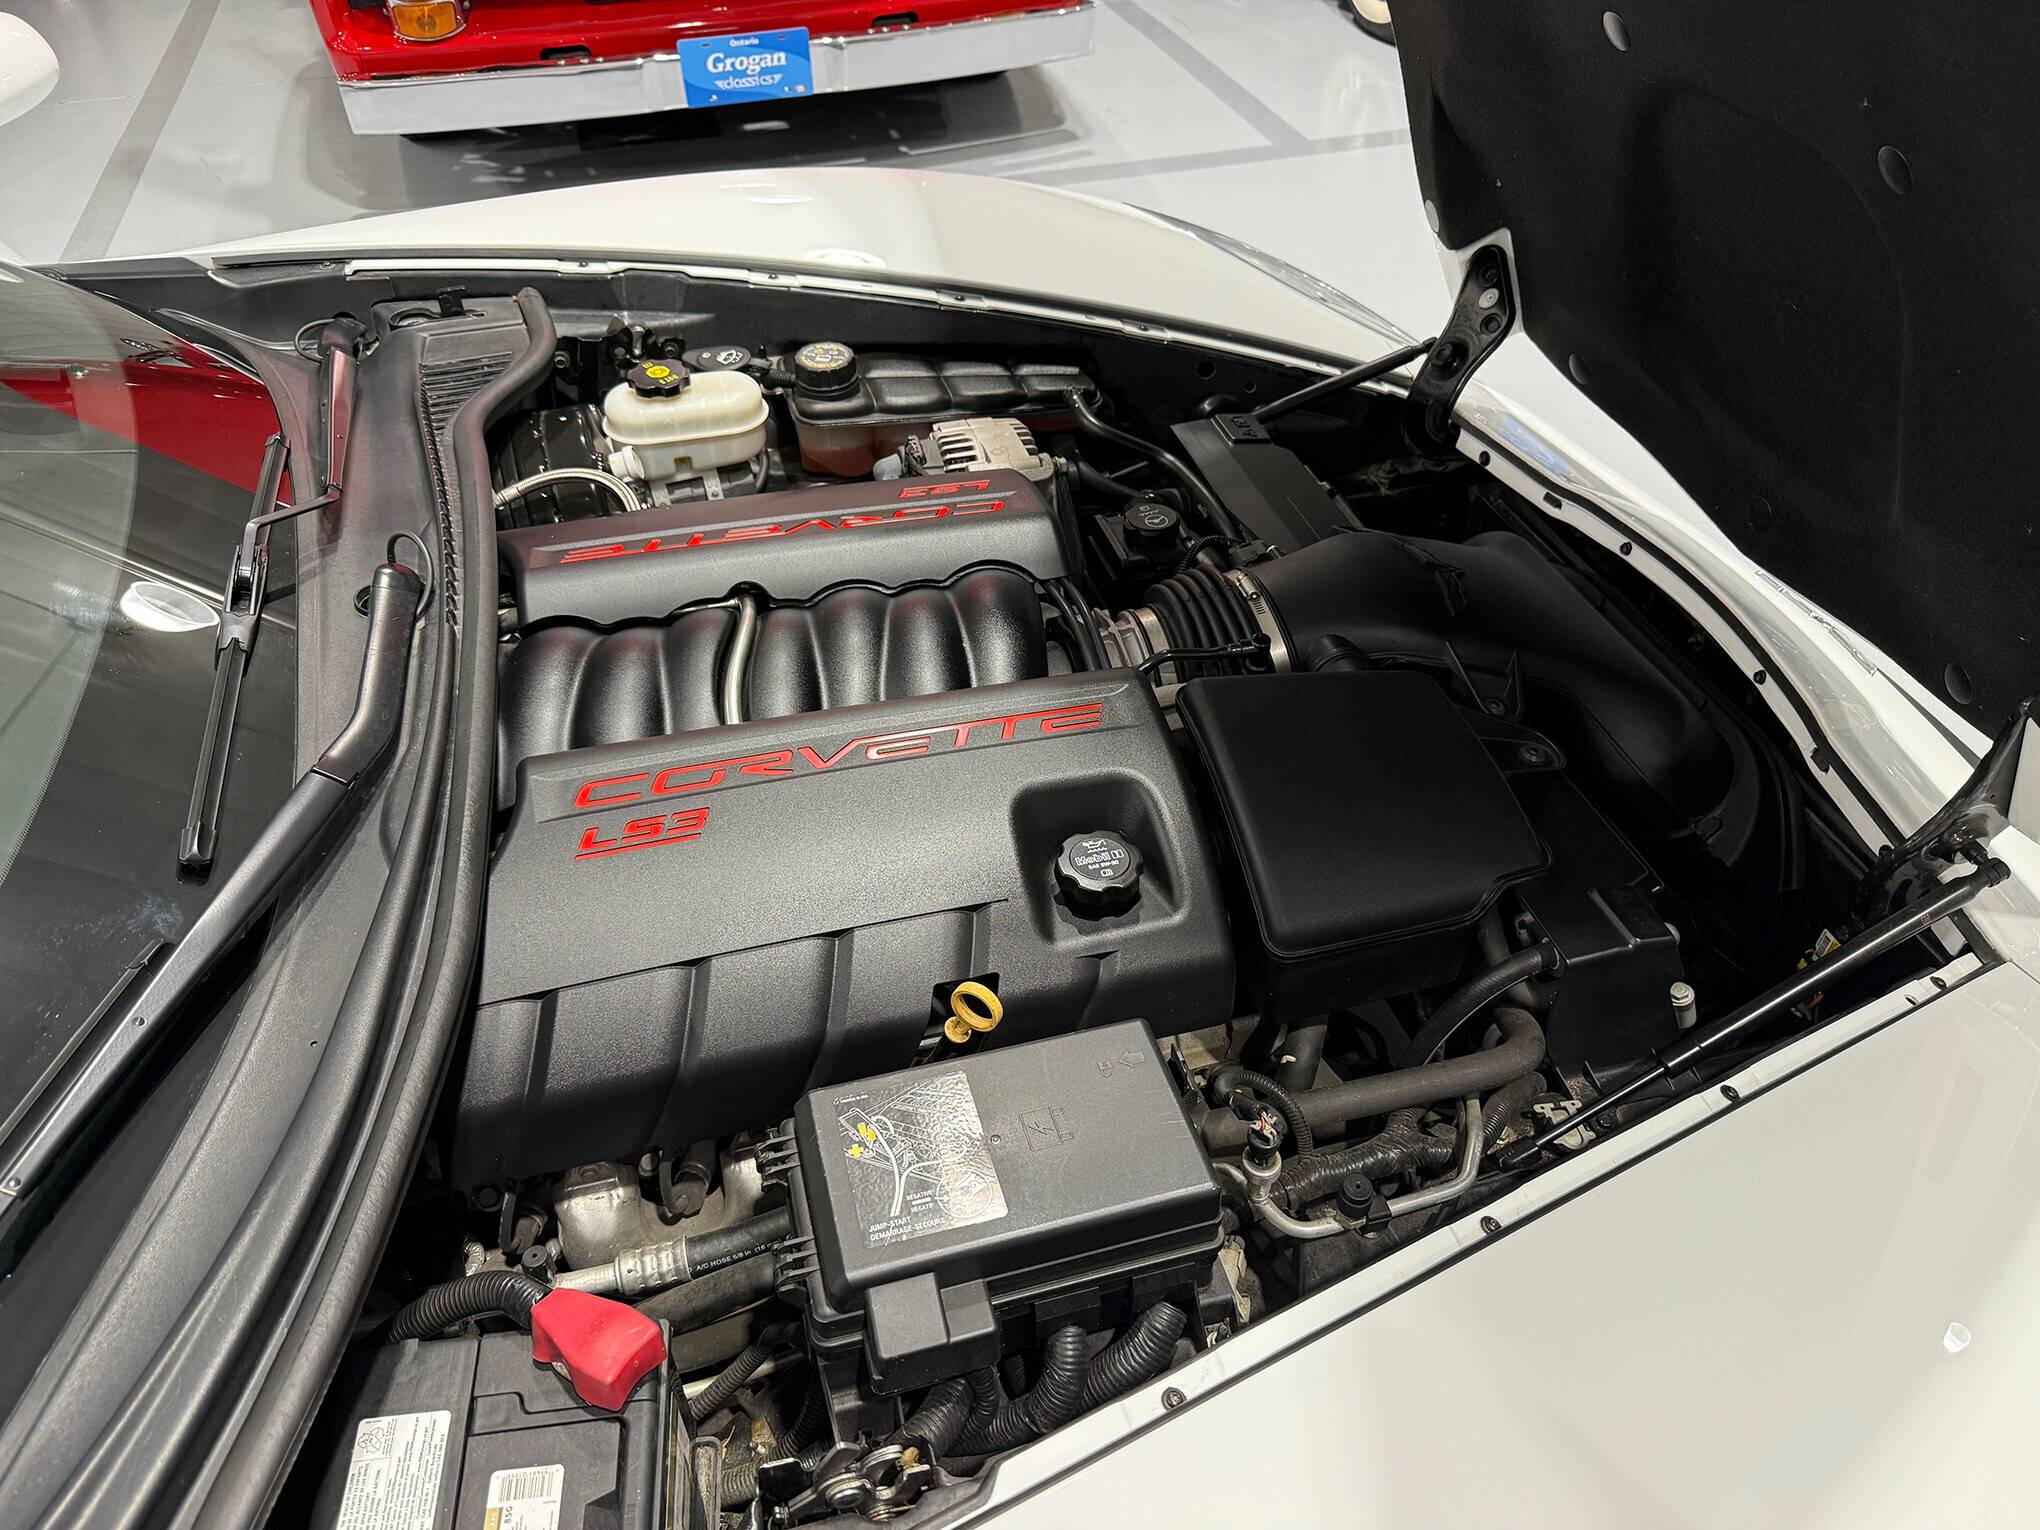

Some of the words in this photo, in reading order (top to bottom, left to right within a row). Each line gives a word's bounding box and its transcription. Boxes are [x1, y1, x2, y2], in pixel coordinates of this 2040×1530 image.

[729, 38, 760, 47] Ontario
[706, 51, 788, 74] Grogan
[719, 74, 779, 89] classics
[898, 480, 991, 498] LS3
[560, 500, 1005, 564] CORVETTE
[574, 703, 1103, 810] CORVETTE
[575, 807, 710, 857] LS3
[1075, 852, 1111, 866] Mobil
[905, 1190, 933, 1201] NEGATIVE
[868, 1216, 911, 1232] JUMP-START
[696, 1263, 709, 1271] A/C
[710, 1255, 732, 1267] HOSE
